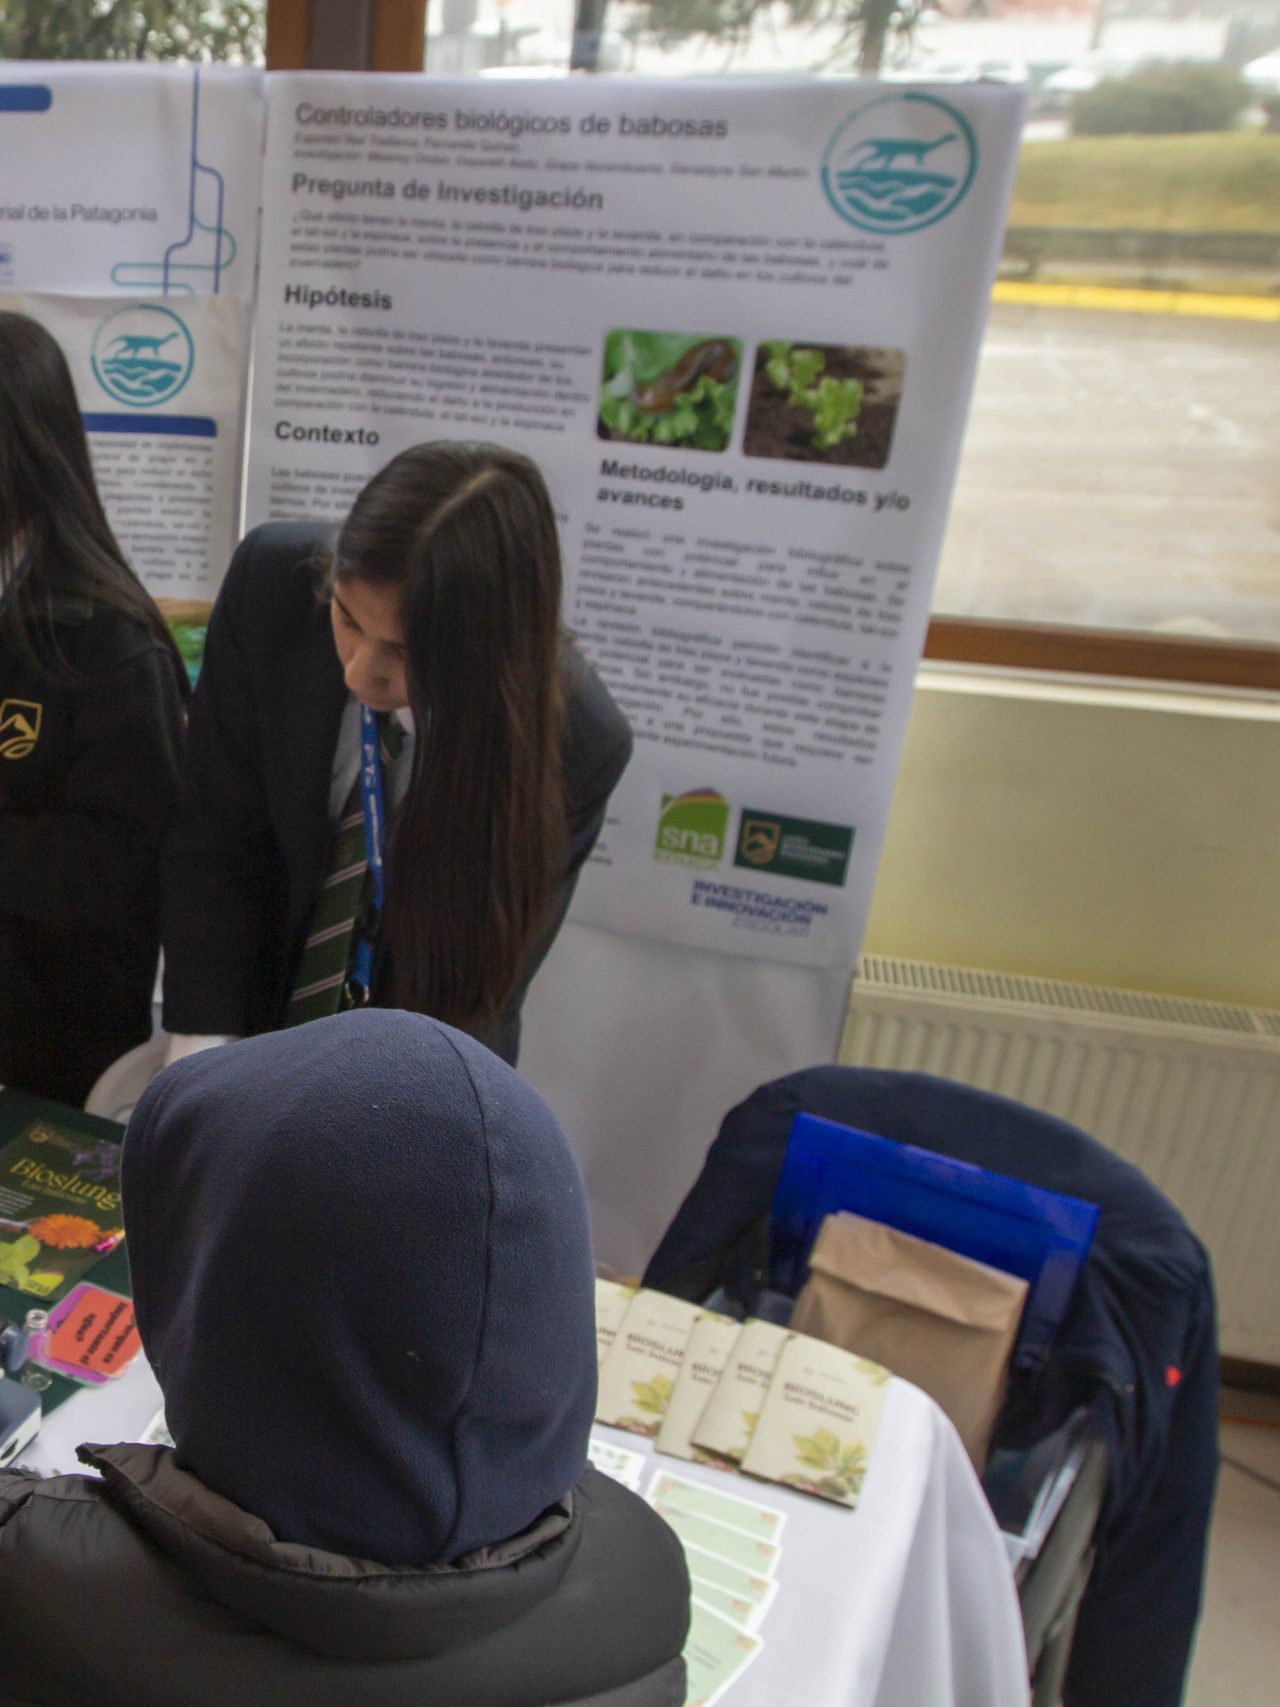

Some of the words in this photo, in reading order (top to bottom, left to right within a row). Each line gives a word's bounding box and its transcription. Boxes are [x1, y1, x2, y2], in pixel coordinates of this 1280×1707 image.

[296, 105, 448, 129] Controladores
[455, 109, 571, 136] biológicos
[577, 115, 611, 136] de
[619, 117, 729, 138] babosas
[292, 175, 395, 198] Pregunta
[403, 179, 430, 200] de
[437, 184, 604, 209] Investigación
[27, 206, 50, 220] de
[51, 206, 67, 221] la
[70, 205, 158, 222] Patagonia
[284, 286, 392, 310] Hipótesis
[275, 423, 380, 445] Contexto
[596, 489, 684, 509] avances
[746, 478, 868, 504] resultados
[875, 491, 911, 514] y/o
[661, 825, 719, 855] sna
[9, 1157, 122, 1211] Bioslung
